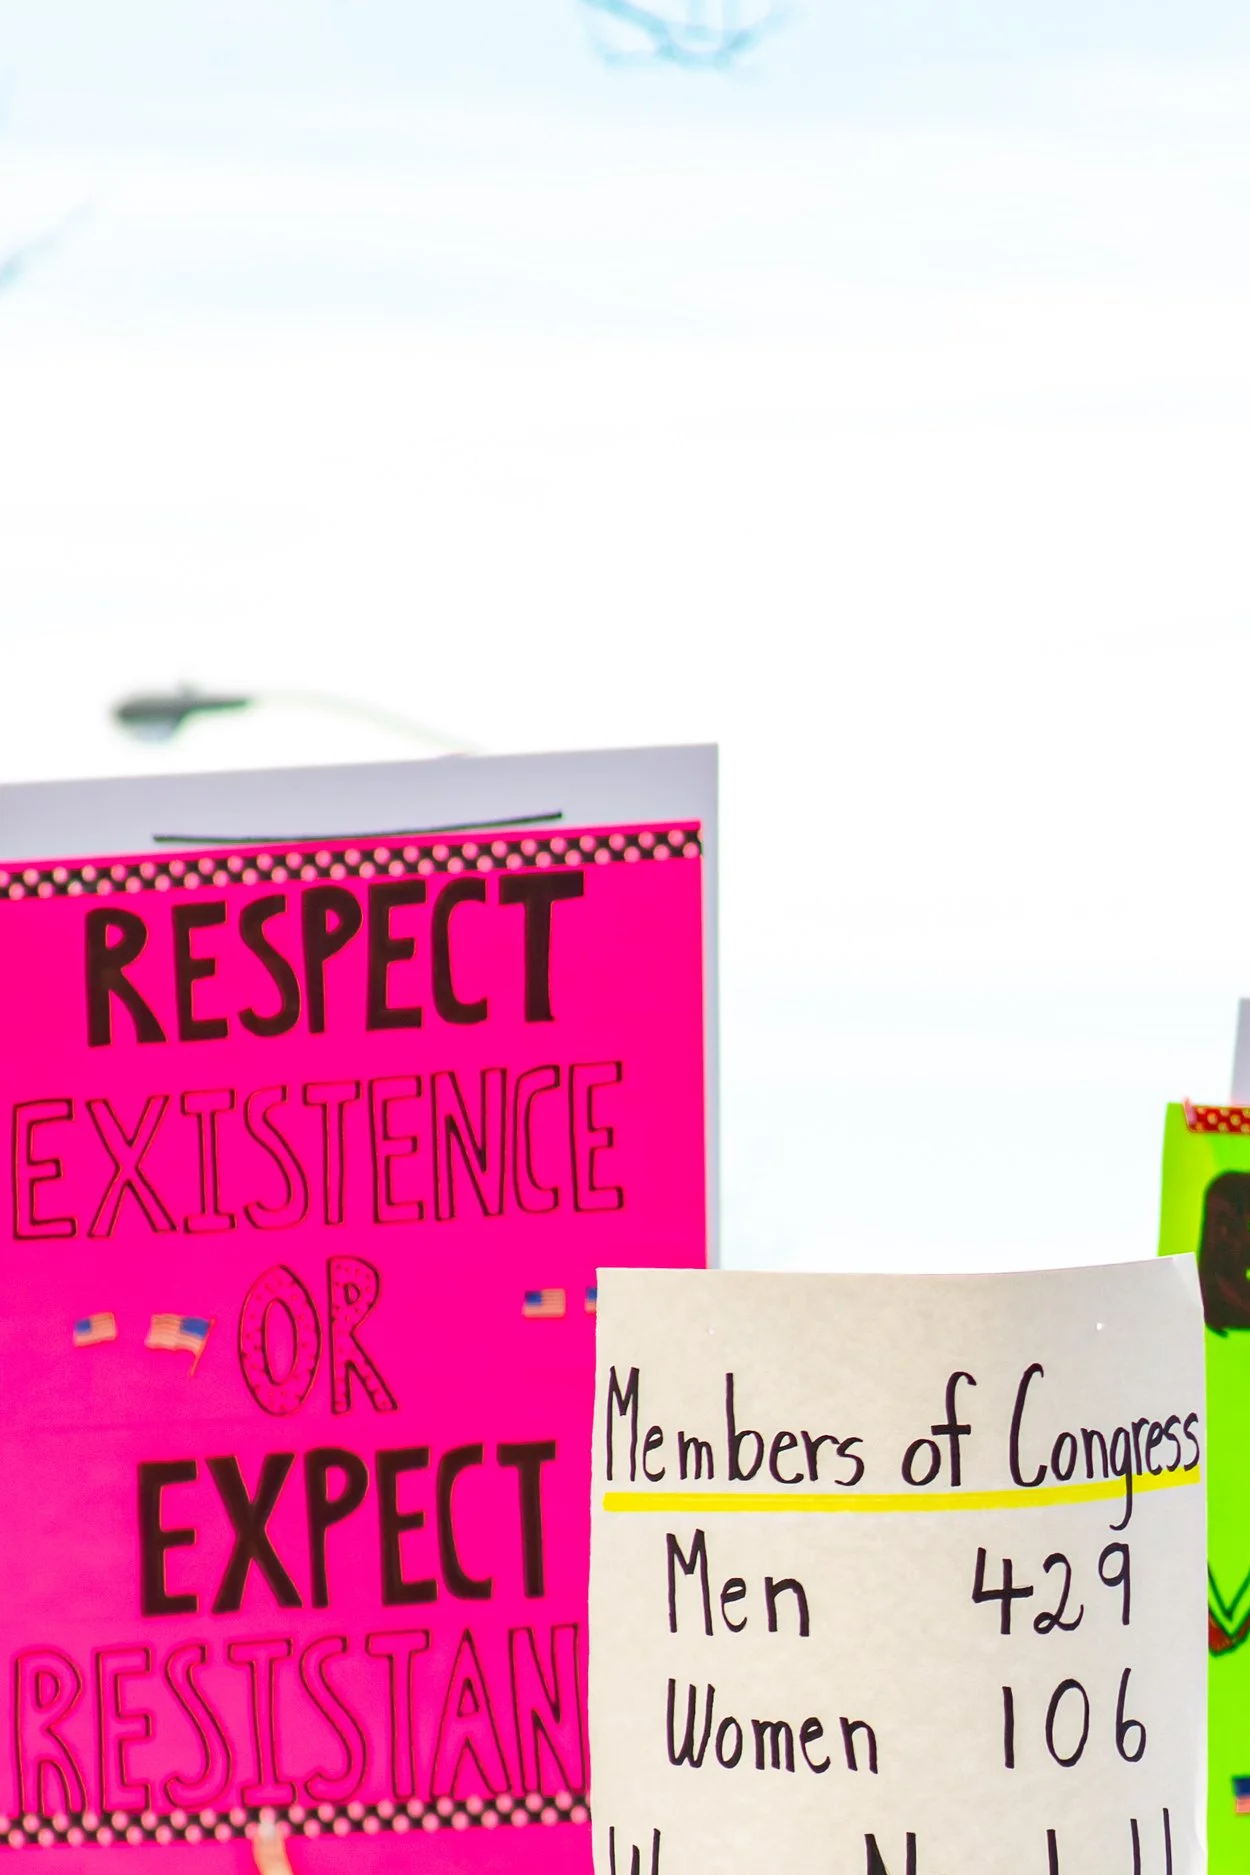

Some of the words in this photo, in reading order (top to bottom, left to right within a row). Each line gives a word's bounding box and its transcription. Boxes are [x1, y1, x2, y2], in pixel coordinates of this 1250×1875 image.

[84, 870, 584, 1047] RESPECT
[11, 1060, 626, 1241] EXISTENCE
[237, 1255, 399, 1416] OR
[137, 1440, 557, 1617] EXPECT
[607, 1366, 865, 1486] Members
[902, 1372, 977, 1487] of
[1009, 1363, 1199, 1531] Congress
[666, 1529, 810, 1637] Men
[971, 1542, 1132, 1635] 429
[667, 1678, 878, 1774] Women
[1002, 1667, 1147, 1769] 106
